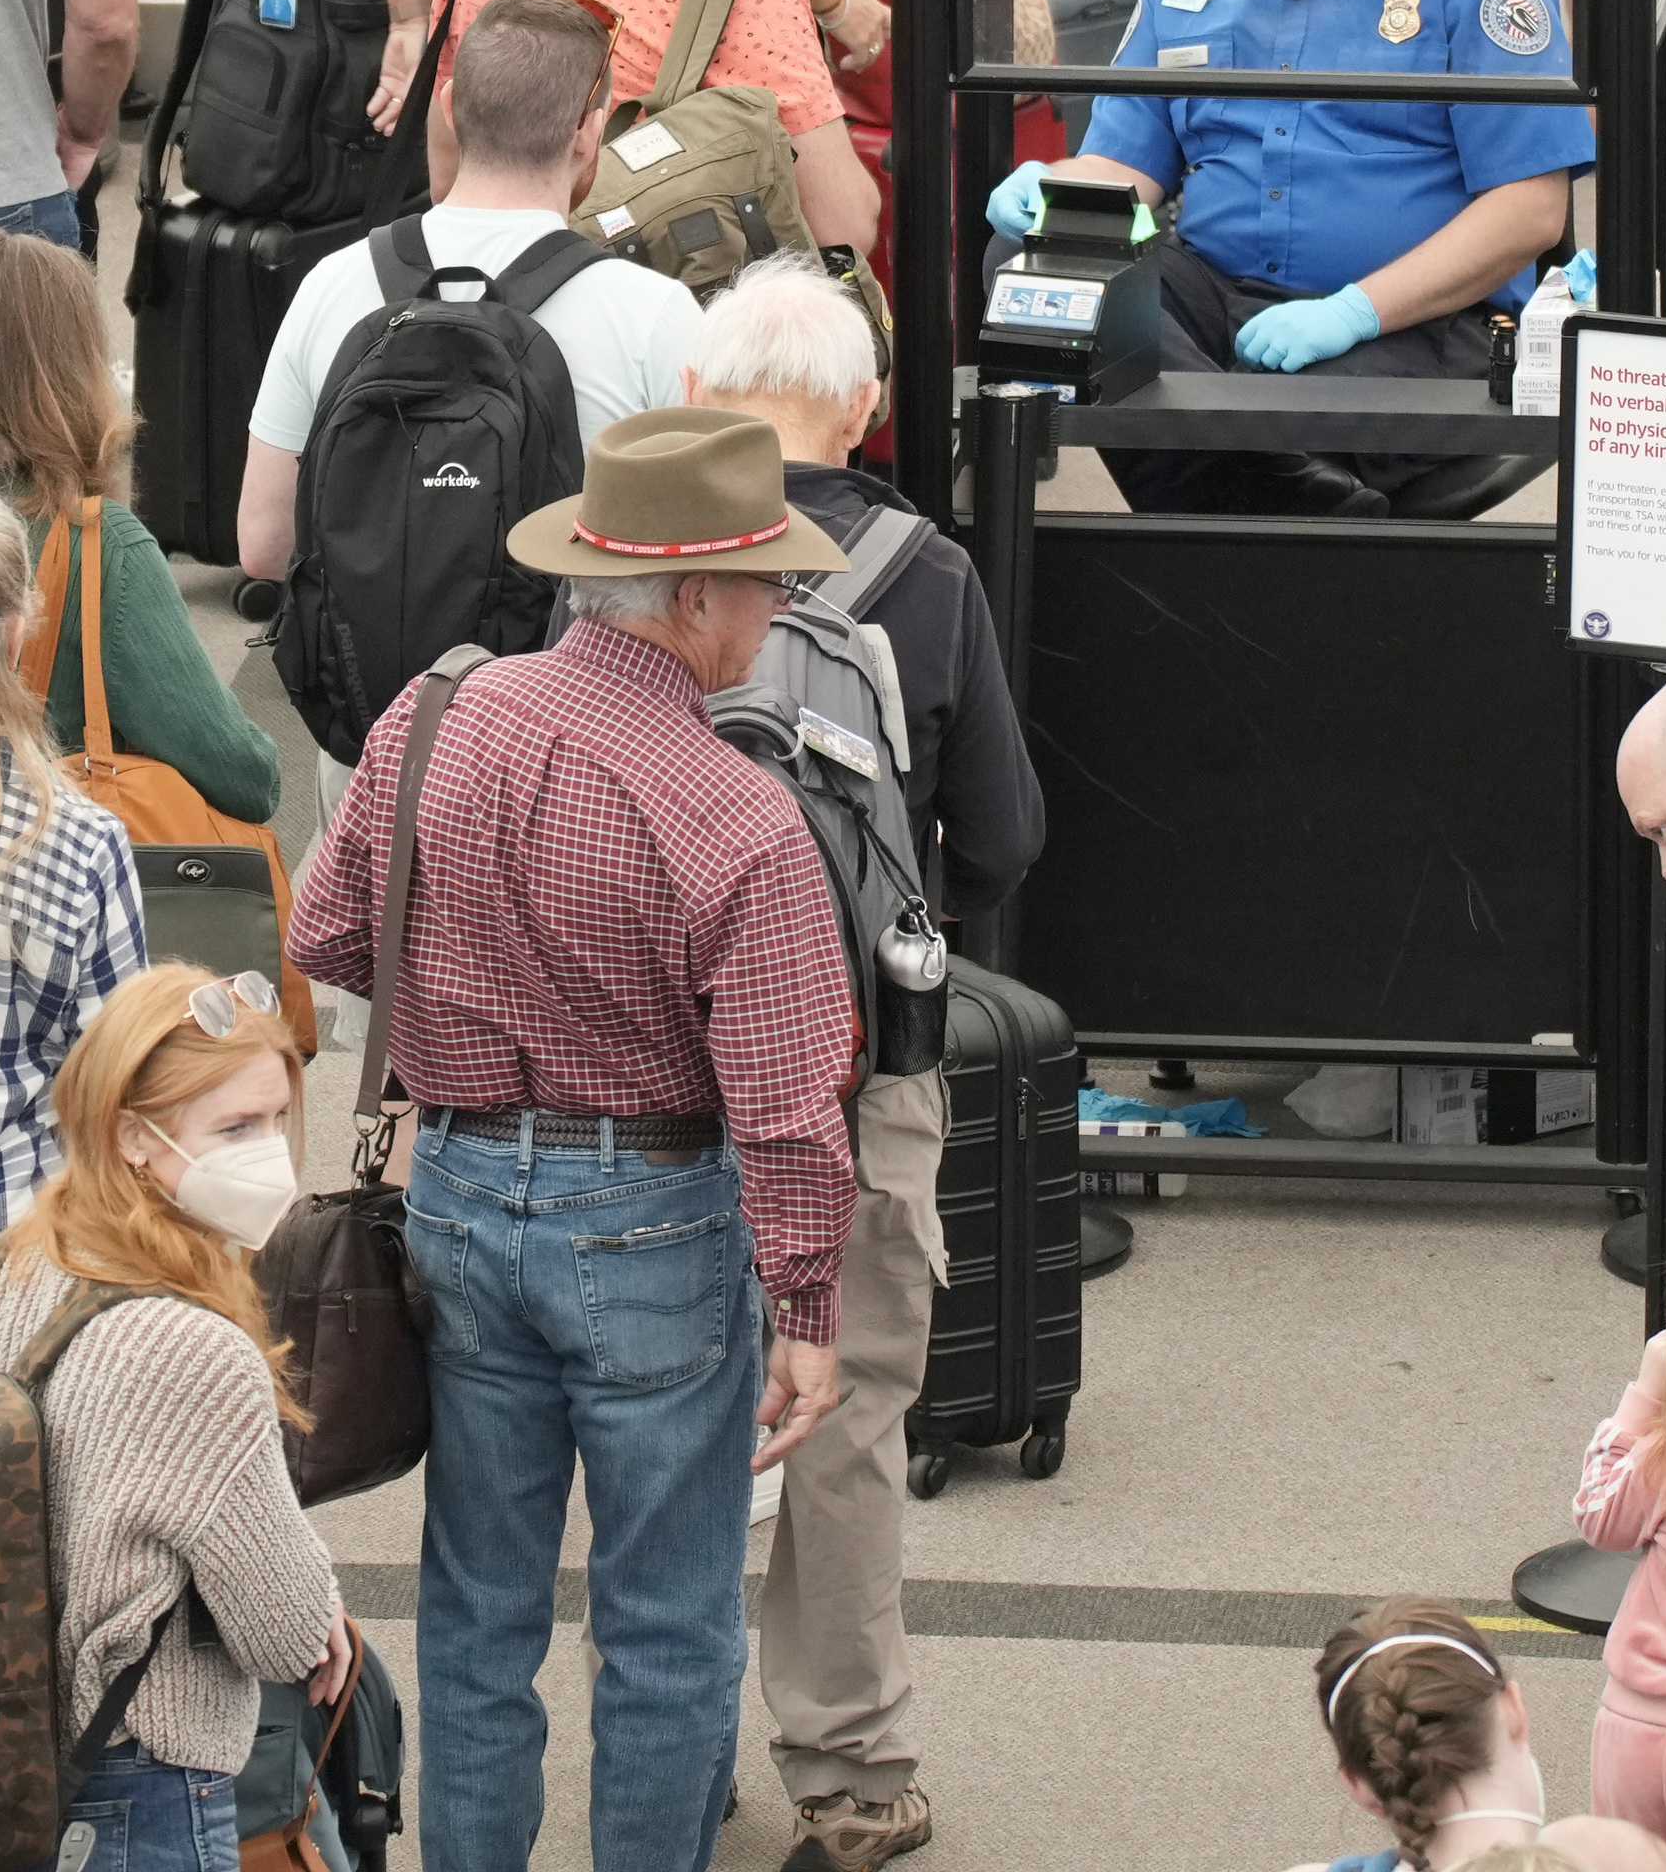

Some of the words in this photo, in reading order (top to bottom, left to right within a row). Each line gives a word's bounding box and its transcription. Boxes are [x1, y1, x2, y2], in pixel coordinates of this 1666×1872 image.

[1591, 365, 1613, 381] No
[1590, 391, 1612, 407] No
[1589, 417, 1612, 433] No
[1589, 437, 1606, 452] of
[1609, 441, 1640, 458] any
[423, 475, 478, 488] workday
[1587, 479, 1595, 488] If
[1597, 481, 1615, 491] you
[1617, 483, 1658, 496] threaten,
[1588, 492, 1654, 508] Transportation
[1587, 506, 1633, 520] screening,
[1636, 510, 1654, 521] TSA
[1586, 519, 1604, 529] and
[1607, 520, 1630, 532] fines
[1631, 523, 1642, 533] of
[1644, 525, 1656, 535] up
[605, 540, 633, 553] HOUSTON
[634, 544, 665, 555] COUGARS
[679, 543, 711, 554] HOUSTON
[711, 538, 740, 550] COUGARS
[1586, 545, 1614, 557] Thank
[1617, 549, 1635, 560] you
[1637, 550, 1650, 560] for
